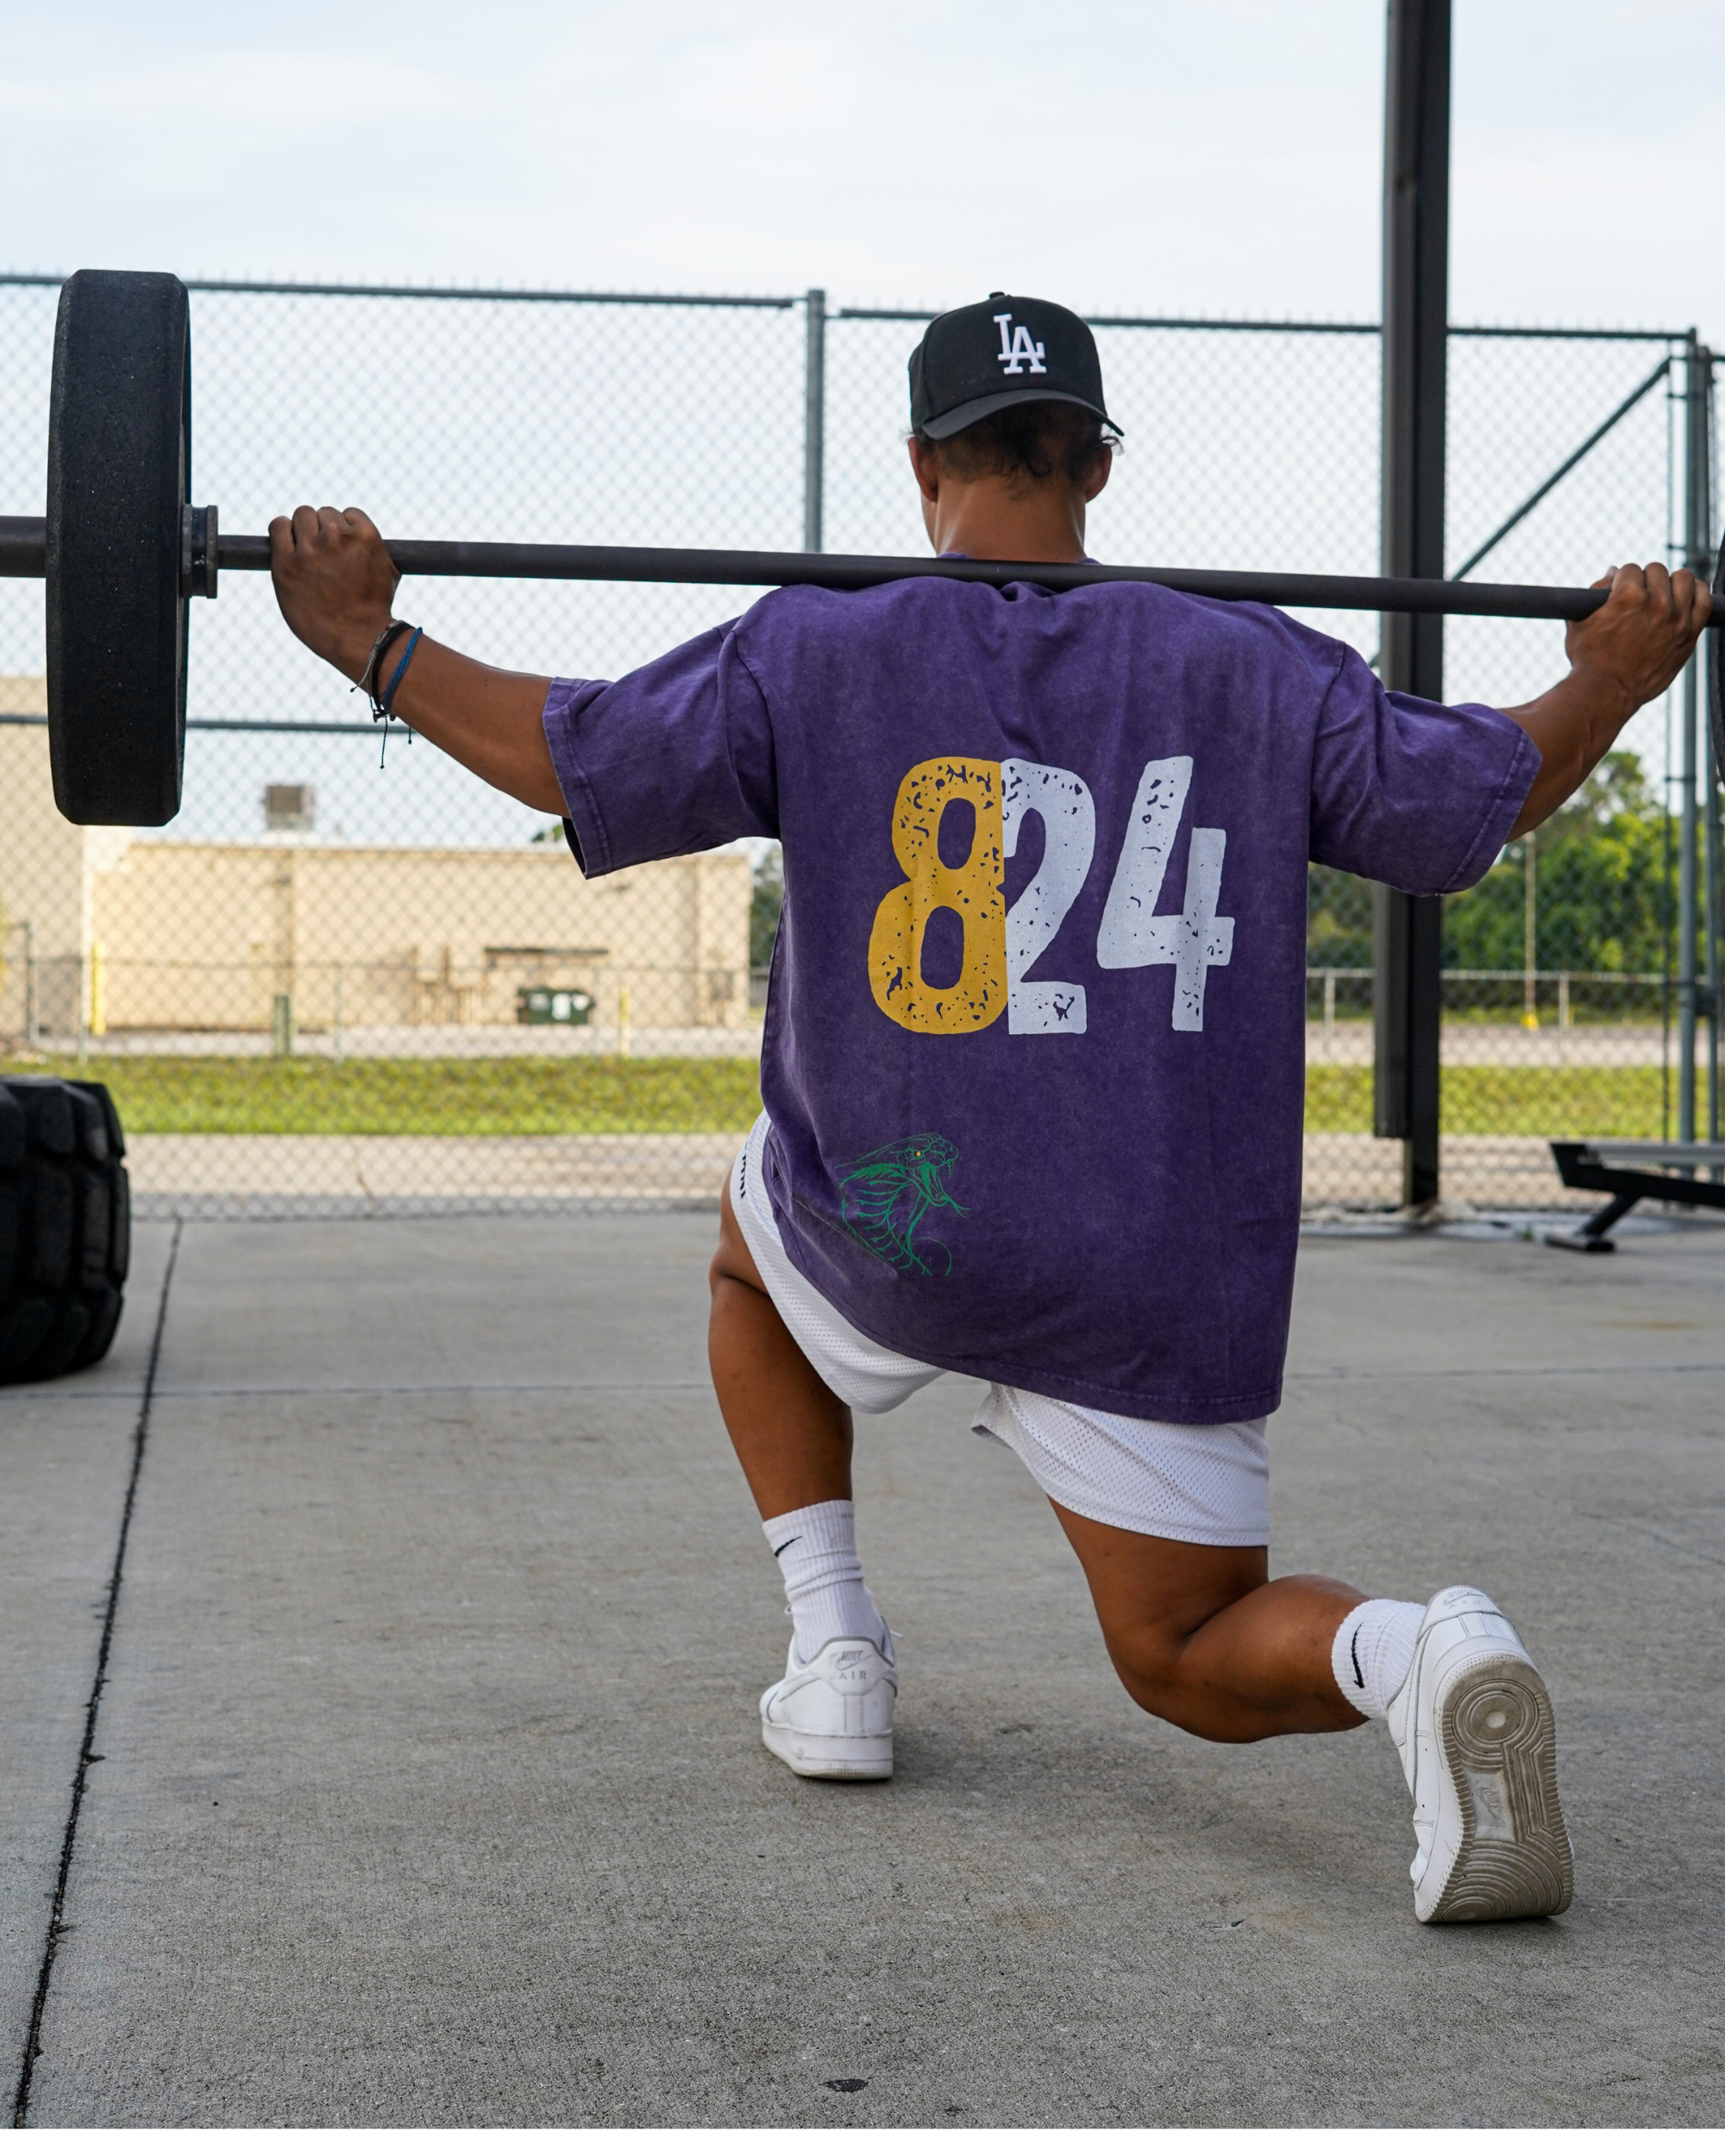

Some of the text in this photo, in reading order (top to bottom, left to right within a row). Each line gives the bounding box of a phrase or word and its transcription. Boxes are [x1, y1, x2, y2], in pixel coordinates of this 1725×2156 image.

[994, 313, 1047, 374] LA
[840, 1650, 863, 1663] NIKE
[839, 1670, 867, 1680] AIR
